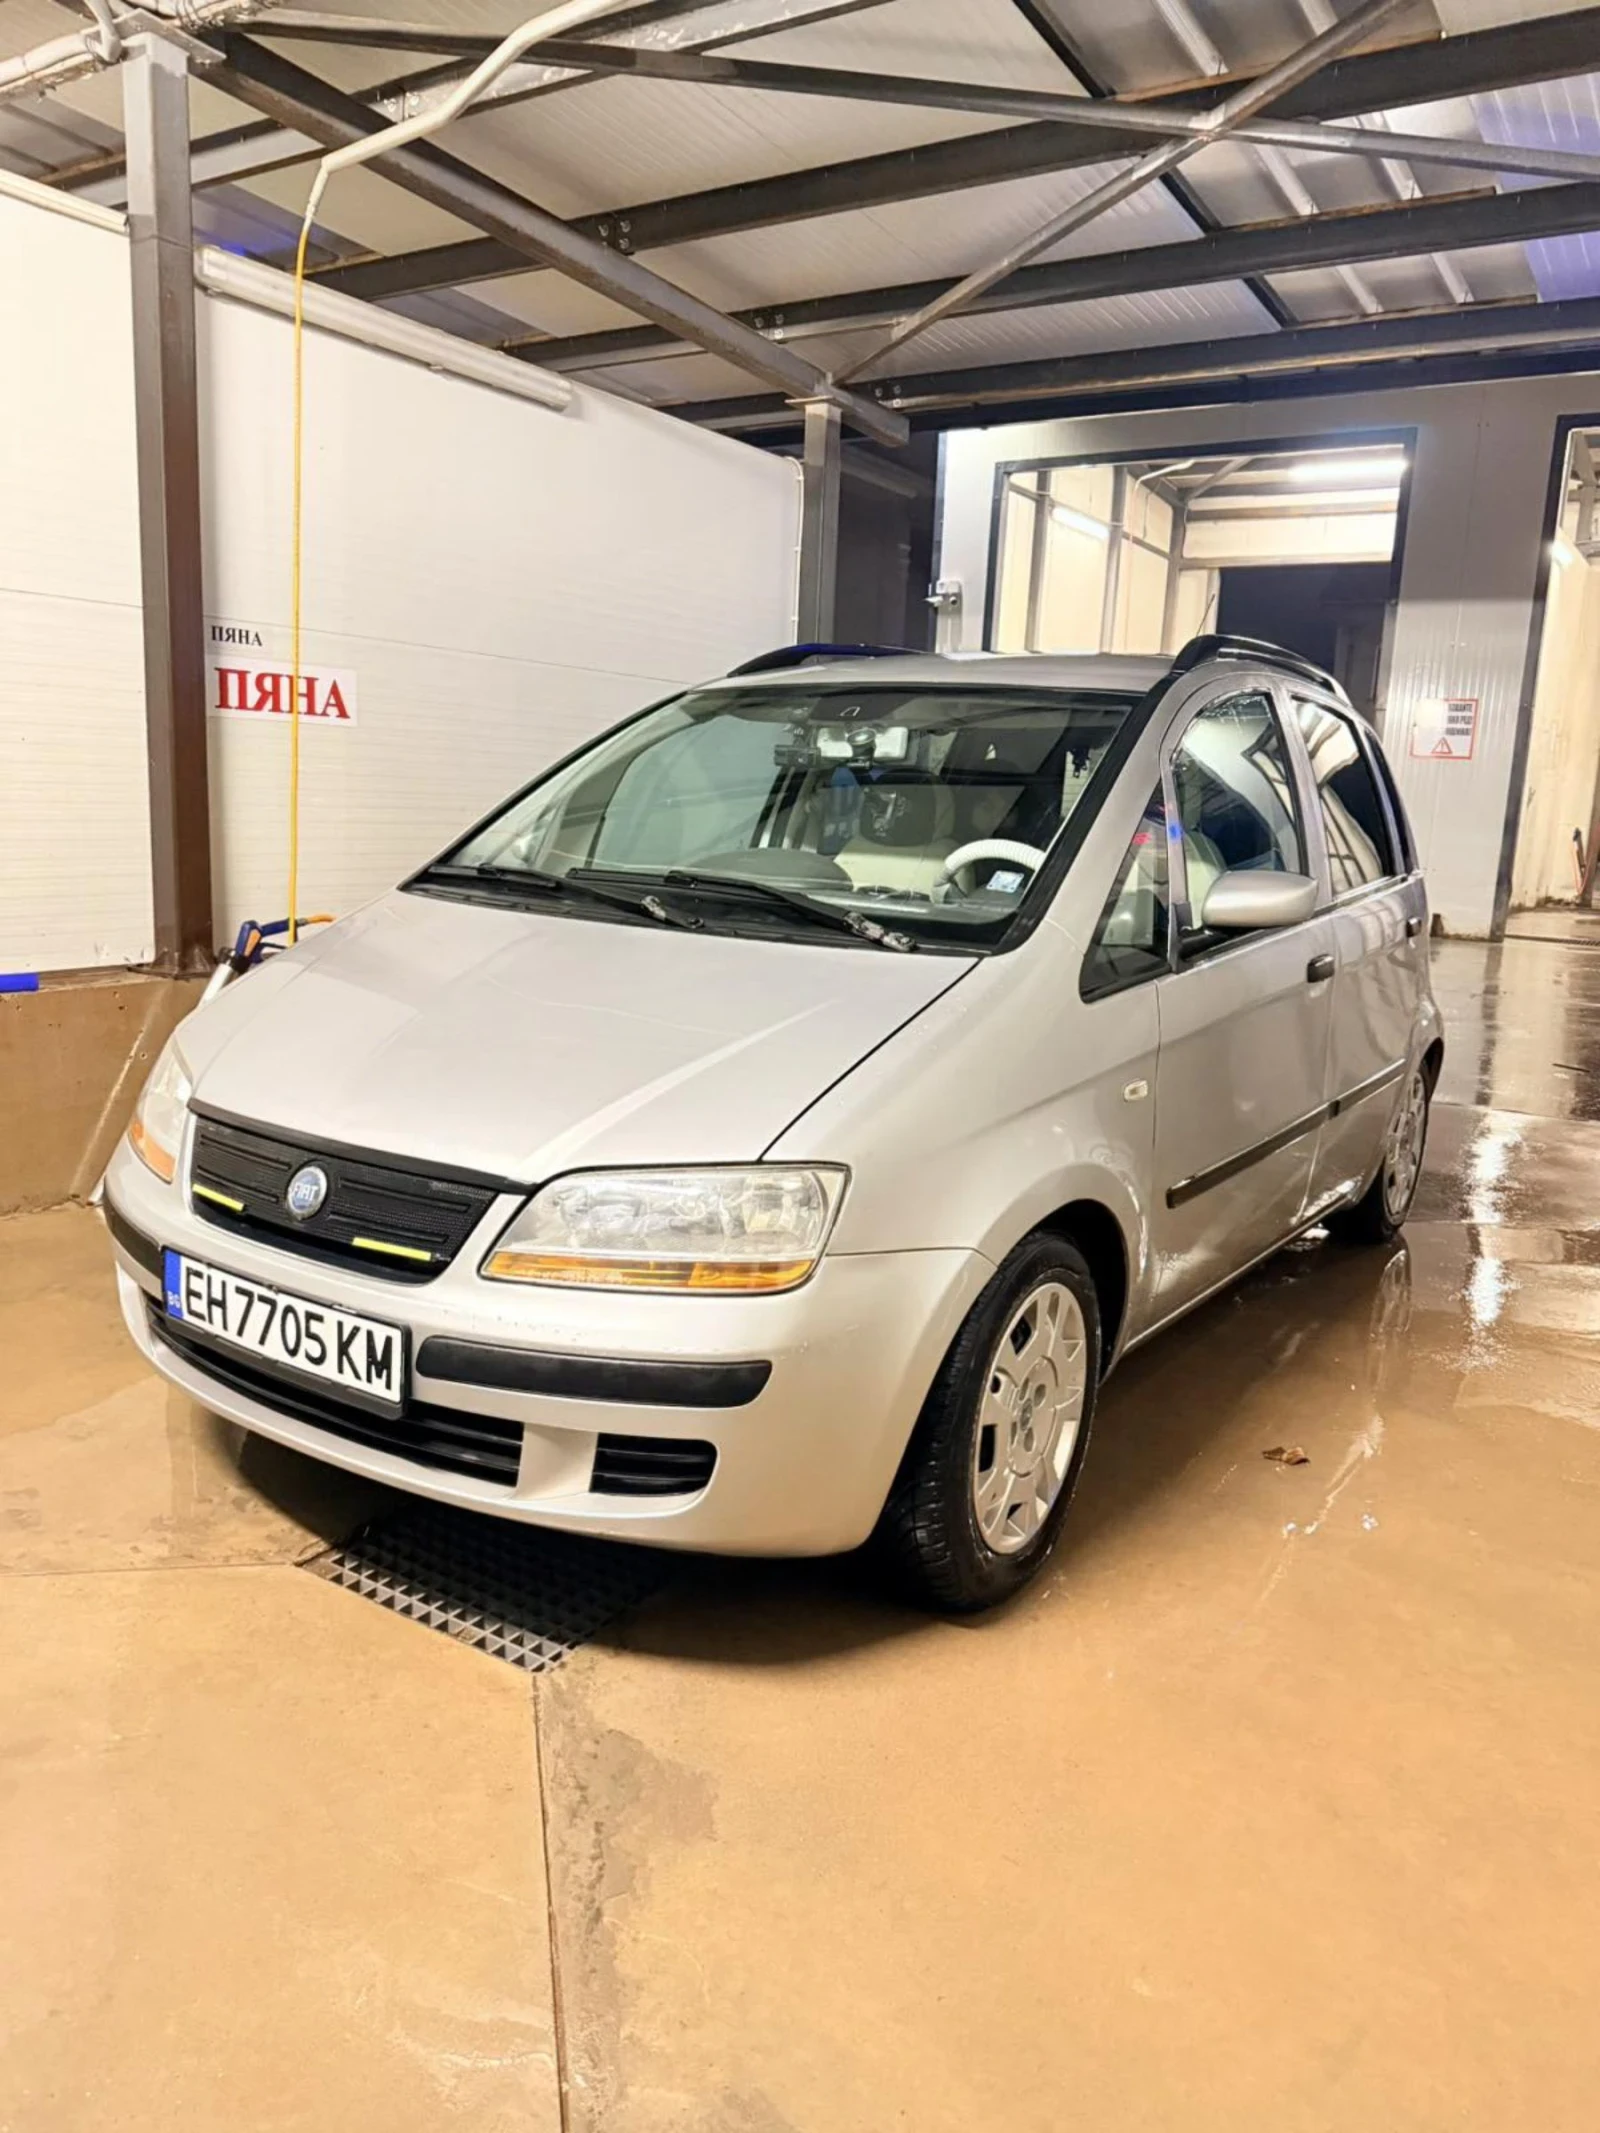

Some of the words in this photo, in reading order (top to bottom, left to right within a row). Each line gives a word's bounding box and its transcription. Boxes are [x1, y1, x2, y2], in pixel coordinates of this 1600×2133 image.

[211, 625, 263, 647] ПЯНА
[213, 667, 351, 719] ПЯНА
[290, 1182, 320, 1201] FIAT
